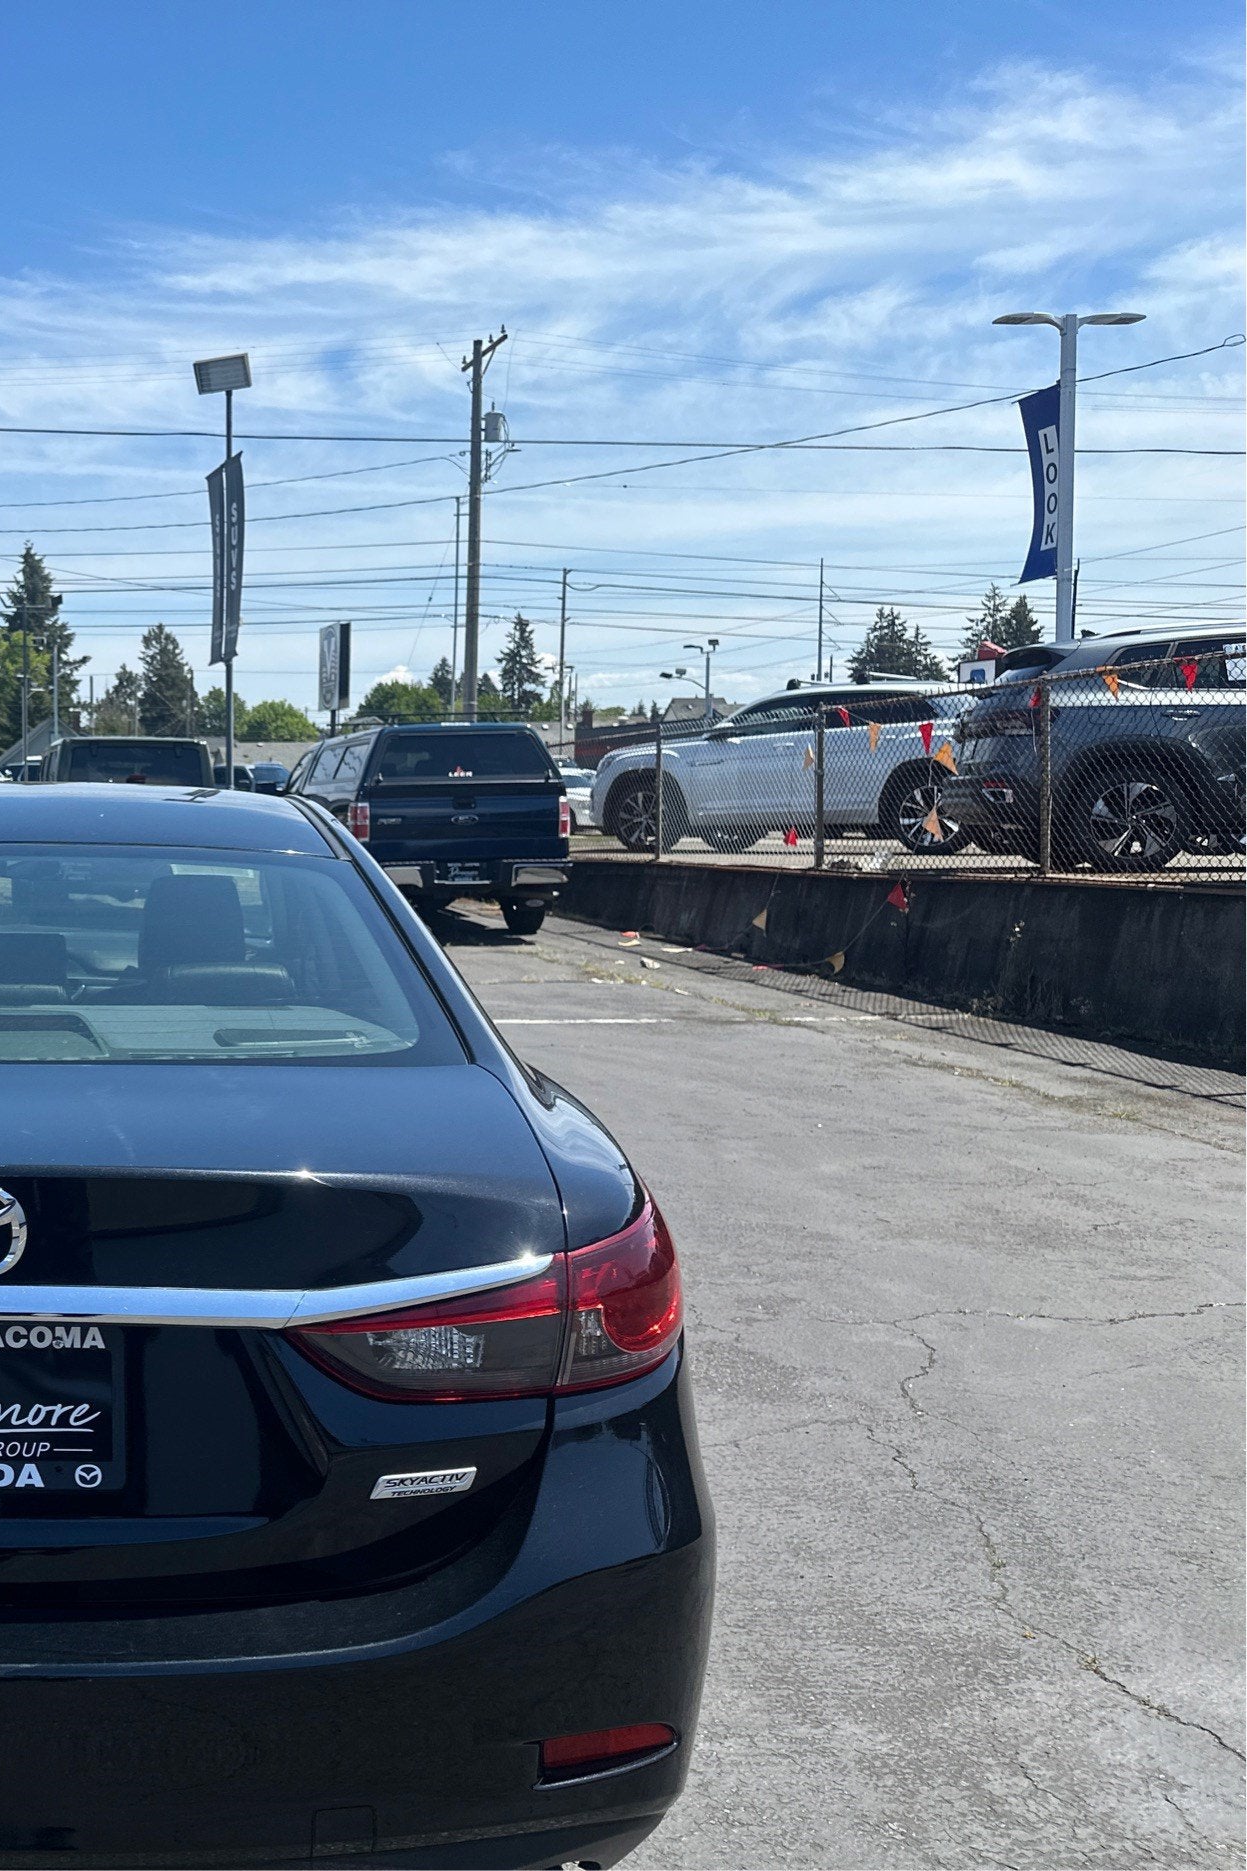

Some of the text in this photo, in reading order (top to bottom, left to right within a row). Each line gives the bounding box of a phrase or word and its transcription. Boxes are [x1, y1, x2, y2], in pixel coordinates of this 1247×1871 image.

[1043, 433, 1058, 546] LOOK
[230, 502, 239, 591] SUVS
[384, 1472, 468, 1488] SKYACTIV
[391, 1485, 458, 1497] TECHNOLOGY
